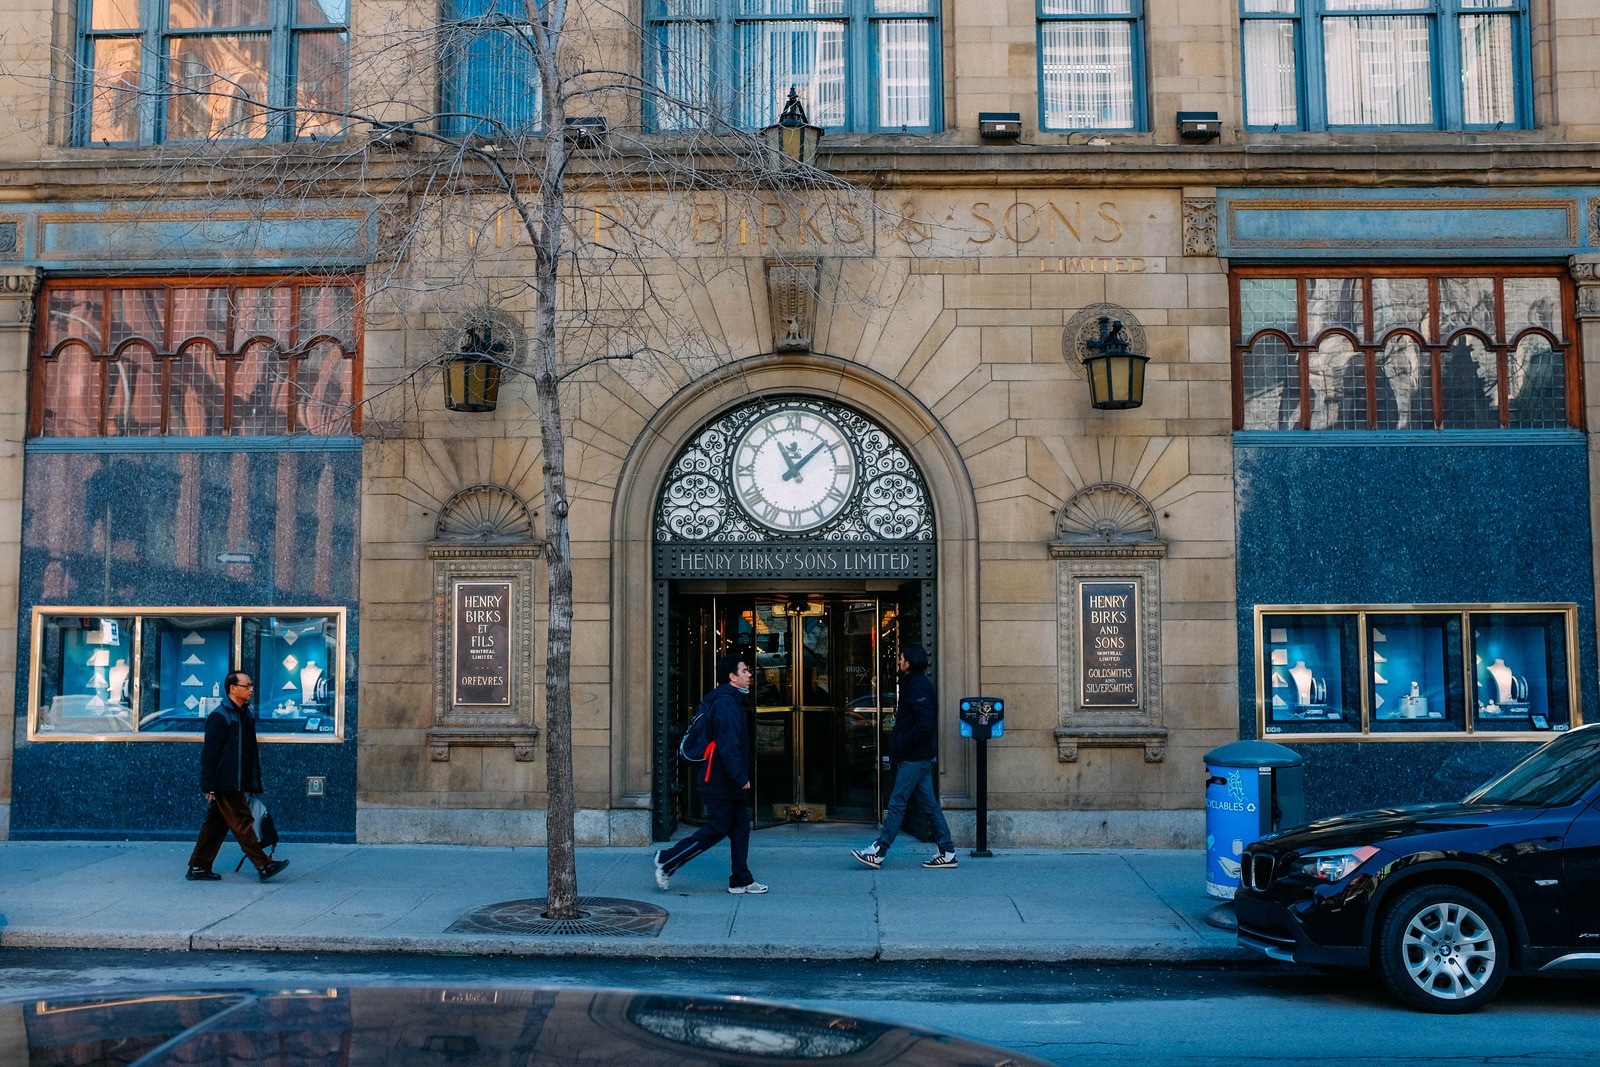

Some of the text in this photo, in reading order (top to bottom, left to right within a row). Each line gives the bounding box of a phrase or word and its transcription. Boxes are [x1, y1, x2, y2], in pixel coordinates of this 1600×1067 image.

[694, 202, 865, 245] BIRKS
[896, 202, 931, 245] &
[966, 201, 1124, 244] SONS
[1039, 256, 1148, 273] LIMITED
[680, 553, 736, 570] HENRY
[740, 553, 785, 570] BIRKS
[794, 553, 837, 570] SONS
[844, 553, 910, 570] LIMITED
[465, 595, 503, 608] HENRY
[1089, 595, 1128, 608] HENRY
[466, 610, 501, 623] BIRKS
[1091, 611, 1127, 624] BIRKS
[478, 624, 488, 634] ET
[1099, 625, 1119, 635] AND
[471, 635, 495, 648] FILS
[1094, 637, 1125, 649] SONS
[1088, 668, 1132, 678] GOLDSMITHS
[1086, 683, 1134, 693] SILVERSMITHS
